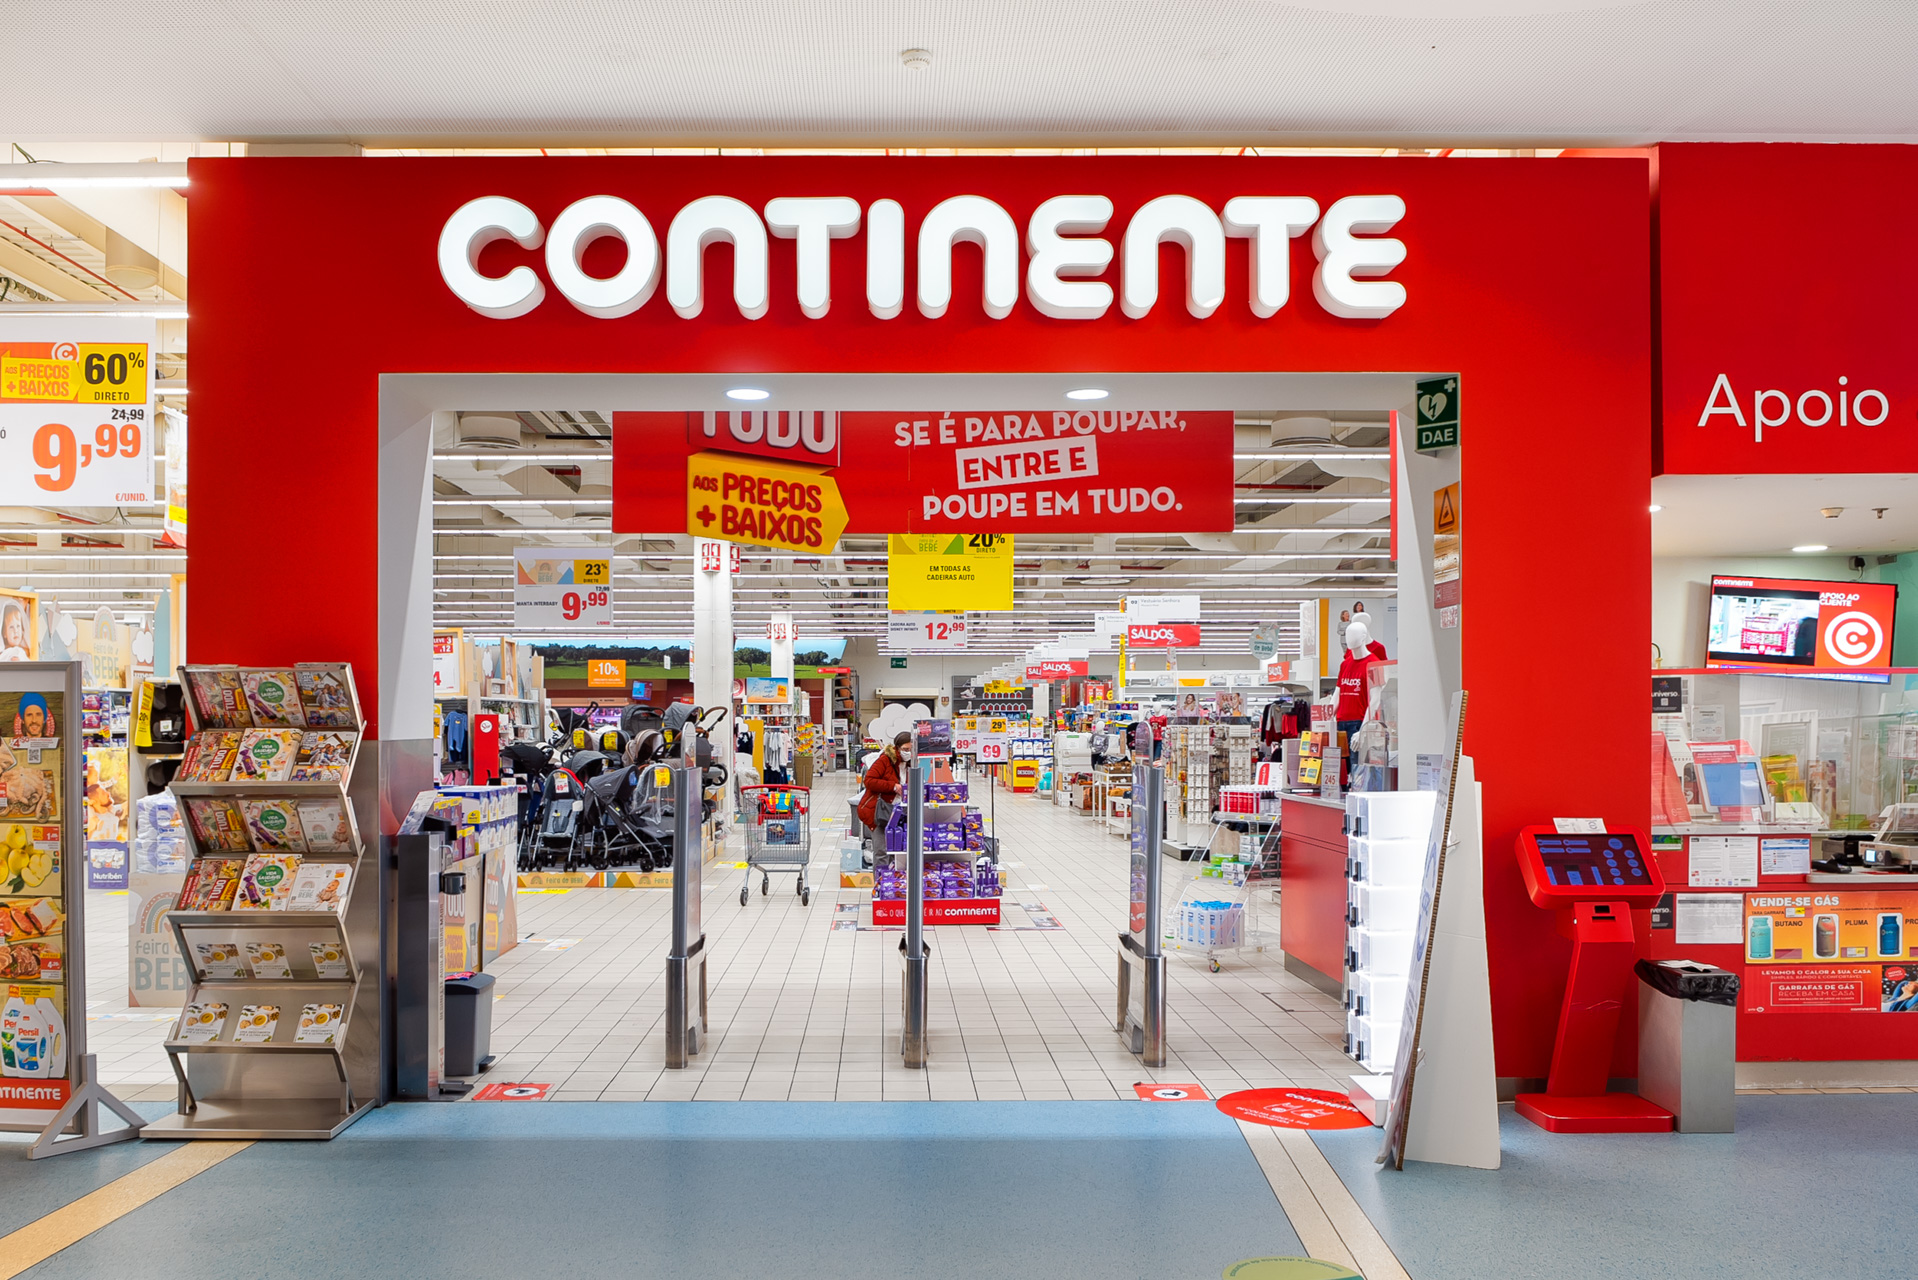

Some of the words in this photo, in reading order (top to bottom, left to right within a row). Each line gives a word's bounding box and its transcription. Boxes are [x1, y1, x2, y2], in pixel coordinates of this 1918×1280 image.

[437, 194, 1407, 320] CONTINENTE
[5, 366, 18, 374] AOS
[20, 363, 70, 380] PREÇOS
[84, 352, 144, 385] 60%
[19, 380, 70, 396] BAIXOS
[94, 392, 130, 400] DIRETO
[112, 409, 144, 422] 24,99
[1697, 373, 1889, 442] Apoio
[894, 420, 930, 447] SE
[939, 412, 956, 444] É
[965, 413, 1045, 443] PARA
[1053, 410, 1187, 436] POUPAR,
[1422, 428, 1454, 445] DAE
[32, 423, 141, 492] 9,99
[963, 449, 1060, 484] ENTRE
[1069, 446, 1087, 472] E
[693, 475, 718, 492] AOS
[116, 493, 148, 502] €/UNID.
[722, 472, 822, 513] PREÇOS
[923, 492, 1028, 520] POUPE
[1036, 490, 1080, 516] EM
[1088, 486, 1183, 514] TUDO.
[722, 504, 822, 548] BAIXOS
[968, 534, 1006, 548] 20%
[585, 563, 608, 576] 23%
[1820, 592, 1846, 600] APOIO
[1820, 599, 1852, 607] CLIENTE
[562, 592, 608, 620] 9,99
[925, 622, 964, 640] 12,99
[1131, 628, 1174, 640] SALDOS
[594, 662, 618, 676] -10%
[1042, 664, 1071, 672] SALDOS
[1340, 678, 1362, 686] SALDOS
[222, 689, 236, 711] TUDO
[210, 749, 228, 770] TUDO
[1324, 775, 1336, 784] 245
[93, 872, 123, 880] Nutribén
[208, 880, 227, 900] TUDO
[1750, 896, 1810, 907] VENDE-SE
[1814, 894, 1840, 906] GÁS
[944, 908, 998, 916] CONTINENTE
[136, 940, 170, 955] feira
